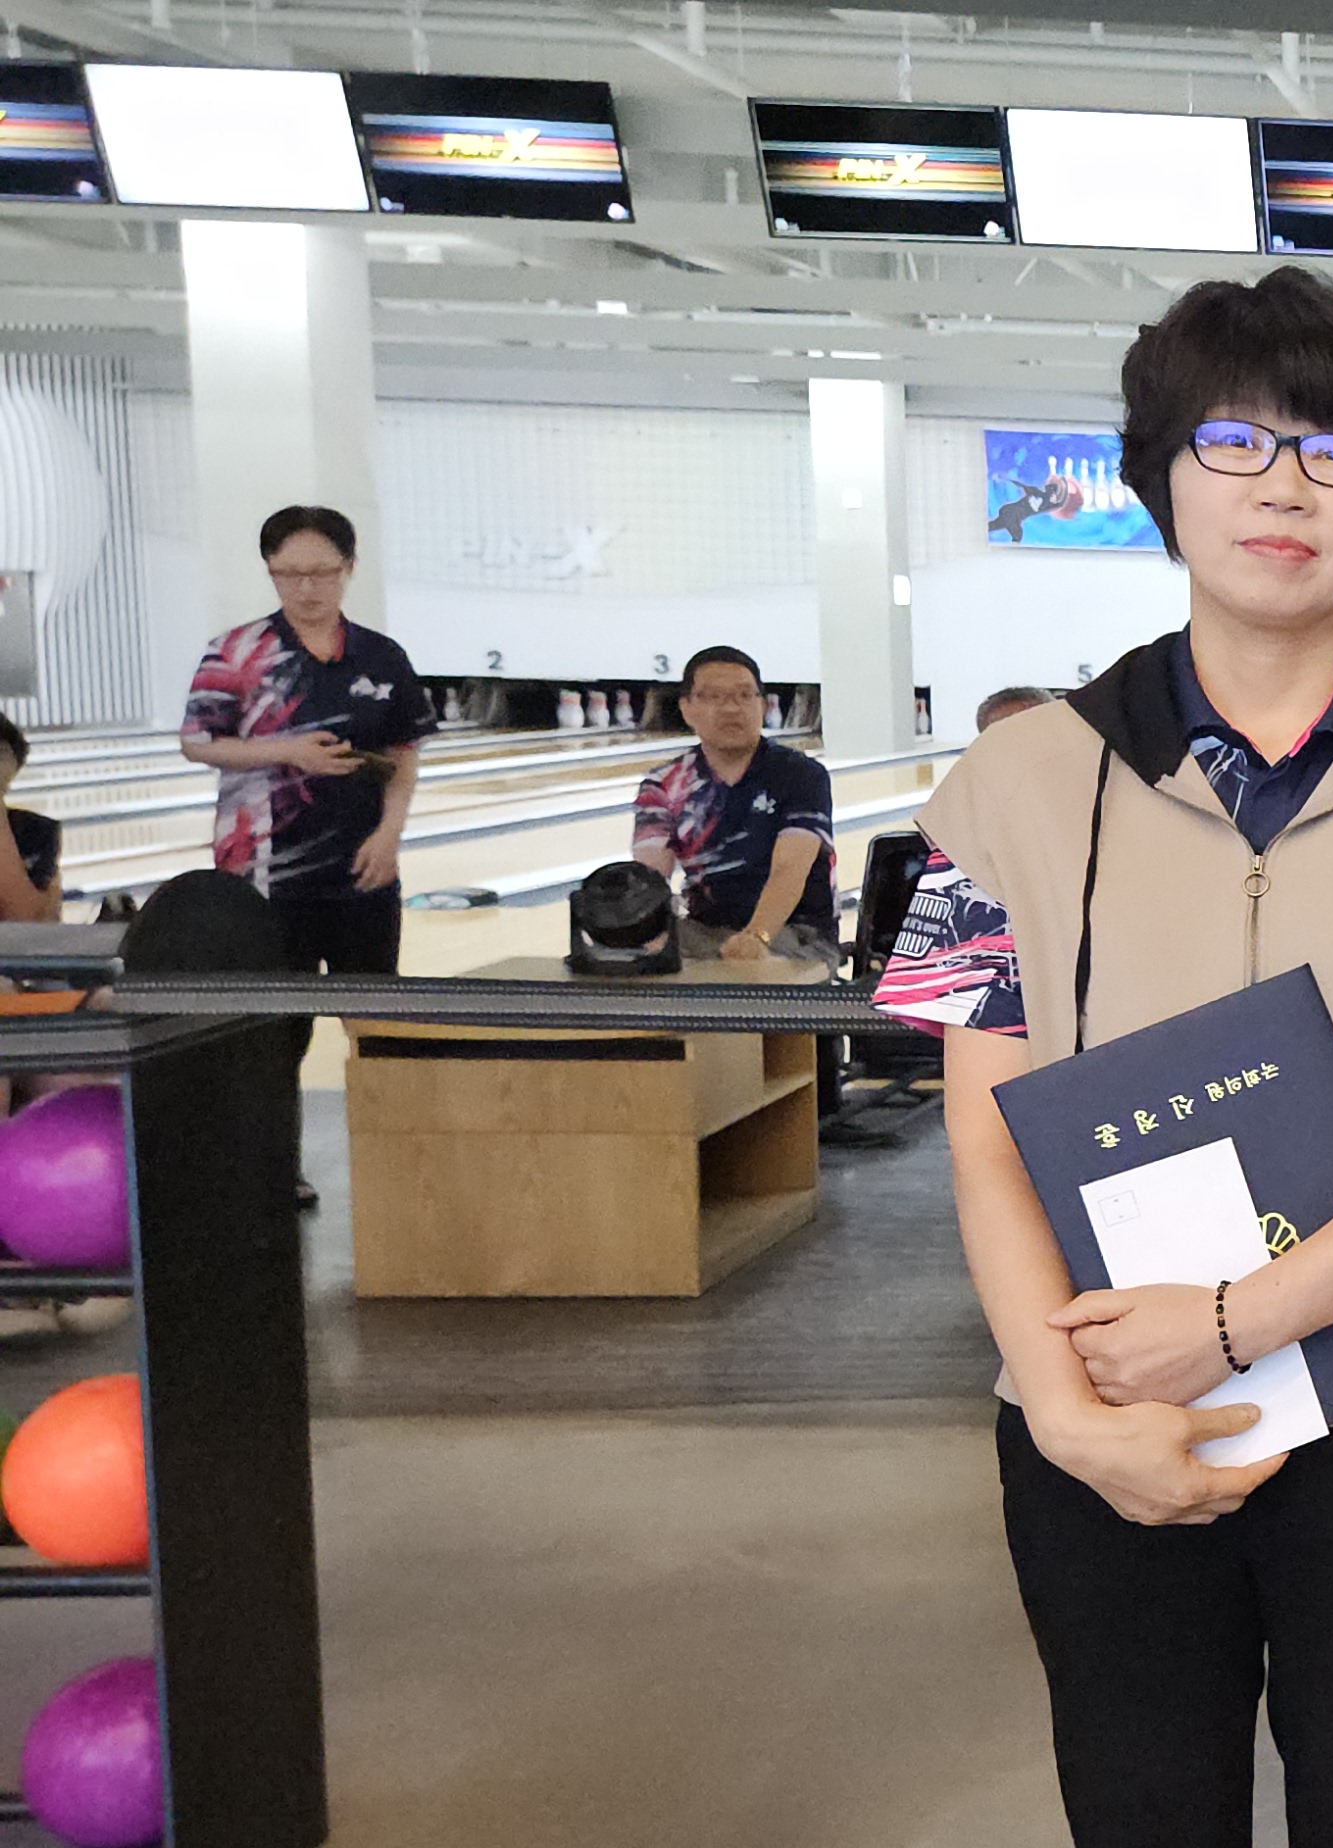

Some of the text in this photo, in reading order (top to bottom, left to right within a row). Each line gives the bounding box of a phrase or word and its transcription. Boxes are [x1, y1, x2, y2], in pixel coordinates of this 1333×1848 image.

[487, 649, 503, 671] 2
[653, 653, 670, 675] 3
[1077, 664, 1093, 684] 5
[1204, 1062, 1280, 1102] 국회의원
